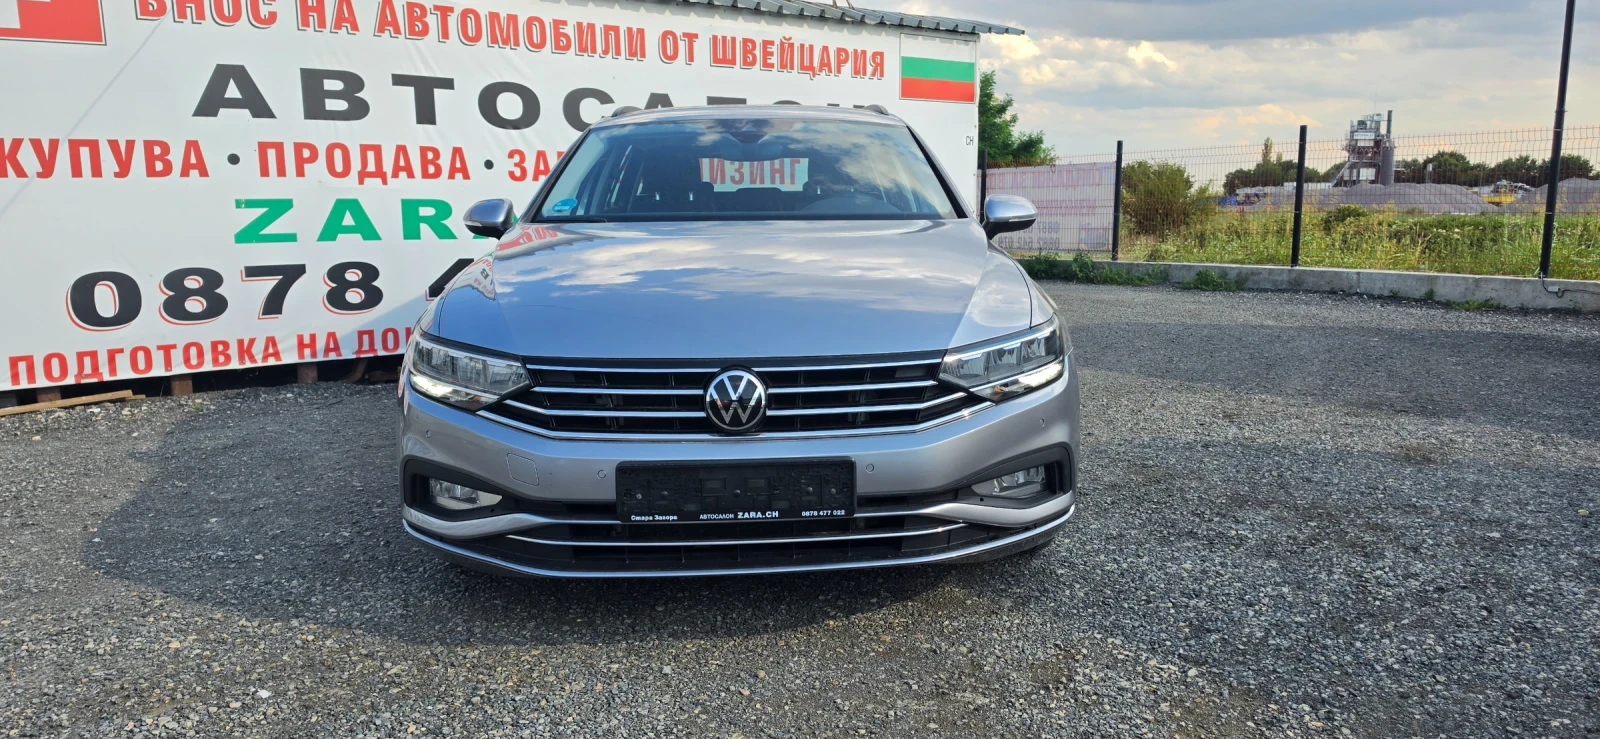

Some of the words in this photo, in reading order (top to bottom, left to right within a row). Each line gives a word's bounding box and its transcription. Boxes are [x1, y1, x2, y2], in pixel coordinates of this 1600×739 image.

[295, 0, 360, 35] НА
[373, 0, 647, 61] АВТОМОБИЛИ
[657, 29, 699, 65] ОТ
[709, 35, 885, 80] ШВЕЙЦАРИЯ
[191, 63, 870, 131] АВТОС
[0, 137, 210, 179] КУПУВА
[257, 141, 471, 186] ПРОДАВА
[507, 149, 565, 182] ЗА
[234, 198, 519, 244] ZAR
[66, 261, 384, 332] 0878
[9, 335, 282, 386] ПОДГОТОВКА
[296, 331, 342, 360] НА
[737, 511, 779, 519] ZARA.CH
